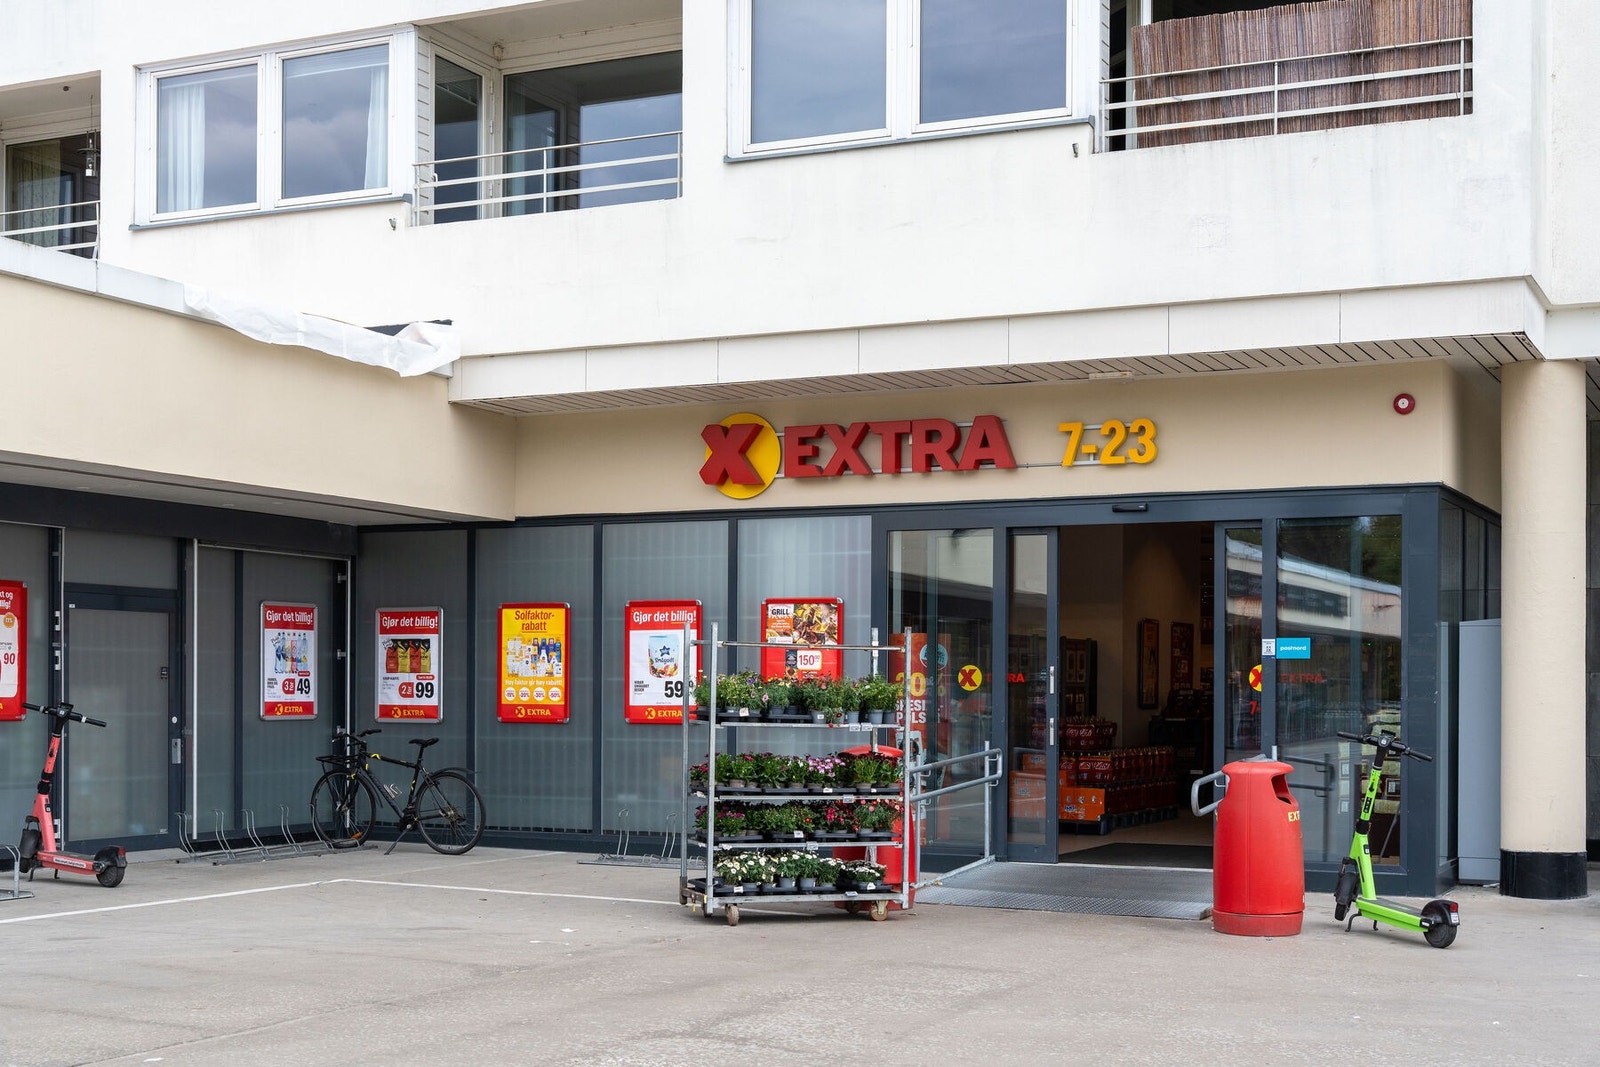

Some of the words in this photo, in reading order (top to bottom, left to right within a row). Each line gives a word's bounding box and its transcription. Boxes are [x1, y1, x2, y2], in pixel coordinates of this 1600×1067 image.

[1058, 418, 1158, 467] 7-23
[699, 423, 764, 485] X
[784, 415, 1016, 478] EXTRA
[266, 610, 281, 623] Gjør
[283, 612, 294, 622] det
[295, 612, 313, 624] billig!
[515, 610, 555, 620] Solfaktor-
[633, 611, 651, 624] Gjør
[654, 611, 669, 622] det
[671, 610, 697, 624] billig!
[382, 616, 399, 629] Gjør
[400, 616, 413, 626] det
[415, 616, 438, 628] billig!
[522, 621, 547, 631] rabatt
[4, 652, 15, 664] 90
[799, 654, 815, 666] 150
[1281, 673, 1326, 684] EXTRA
[296, 678, 310, 695] 49
[415, 681, 435, 698] 99
[664, 680, 684, 698] 59
[403, 709, 425, 717] EXTRA
[527, 708, 551, 716] EXTRA
[657, 709, 683, 718] EXTRA
